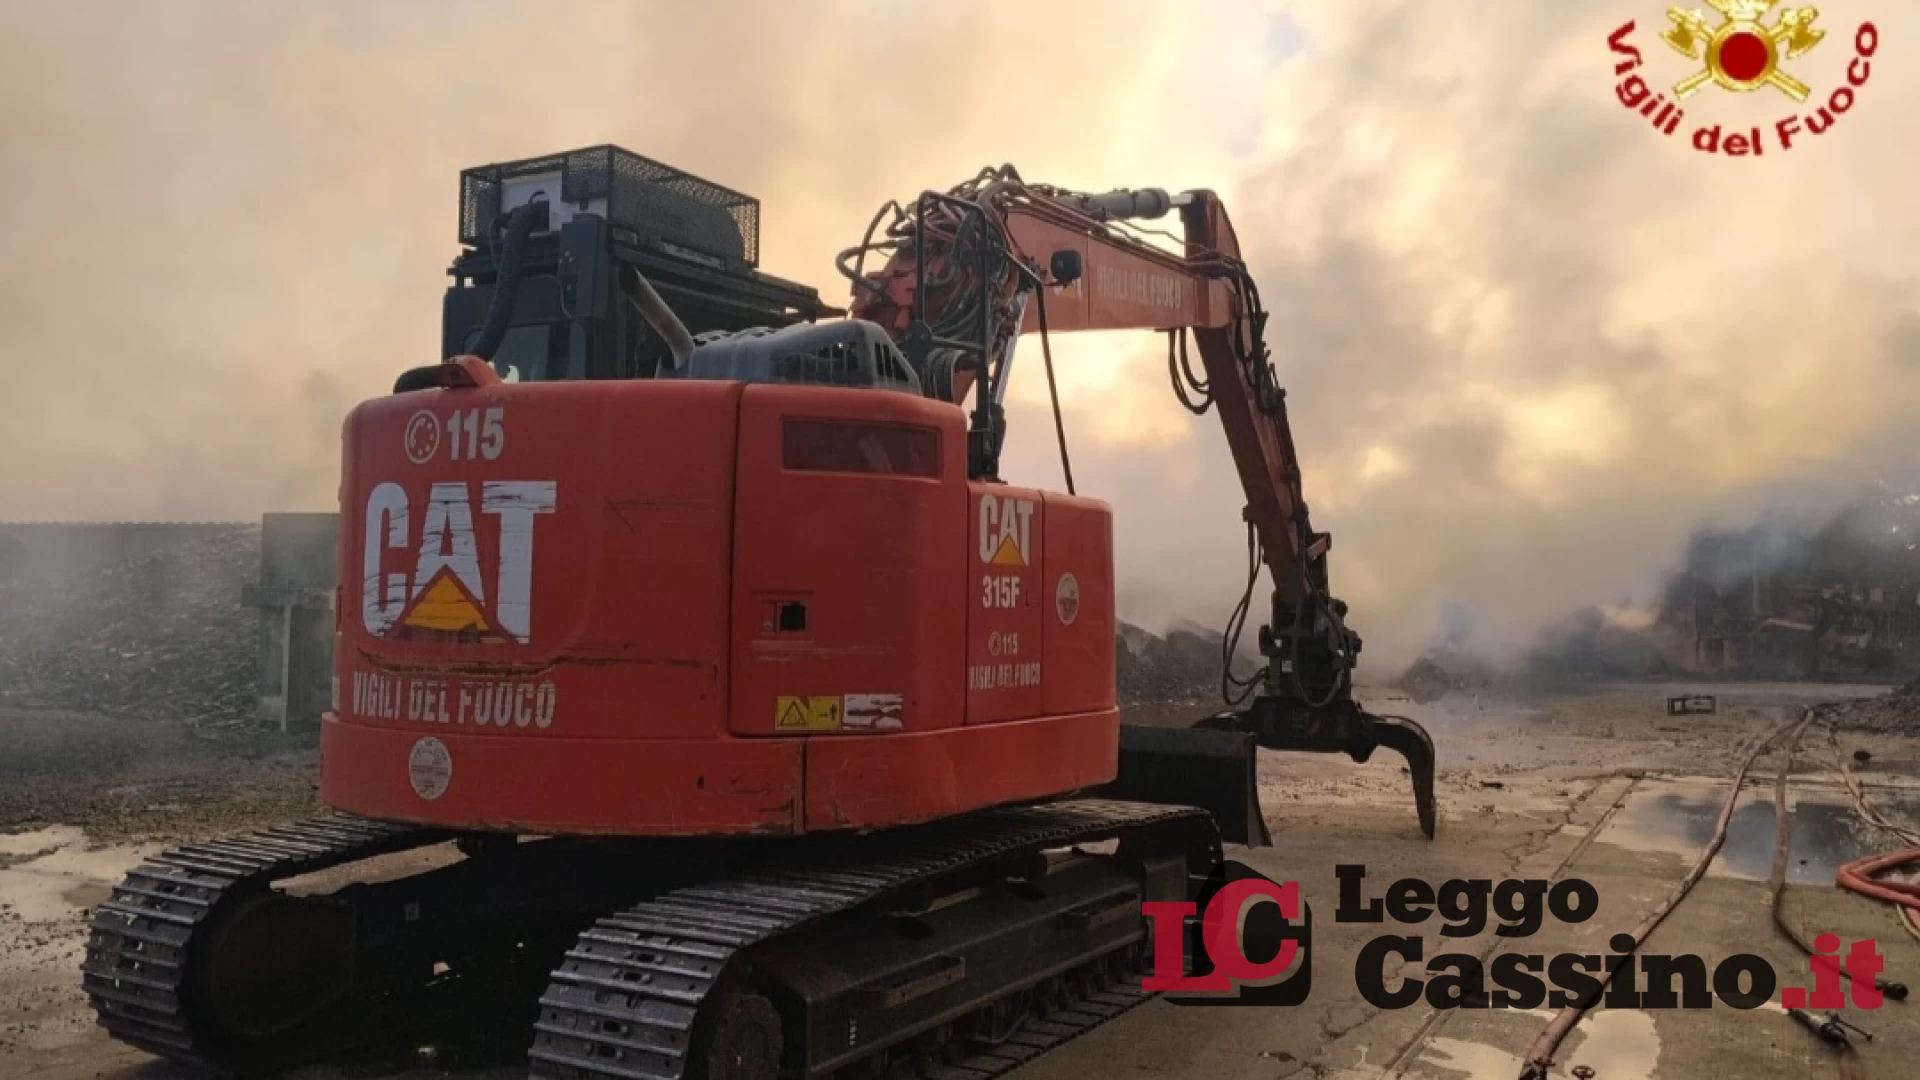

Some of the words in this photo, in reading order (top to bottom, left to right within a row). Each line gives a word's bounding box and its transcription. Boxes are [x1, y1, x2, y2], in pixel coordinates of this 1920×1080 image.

[446, 407, 505, 461] 115
[979, 494, 1034, 567] CAT
[362, 480, 557, 644] CAT
[982, 574, 1021, 608] 315F
[1002, 631, 1019, 657] 115
[353, 671, 402, 720] VIGILI
[408, 678, 450, 724] DEL
[457, 679, 556, 729] FUOCO
